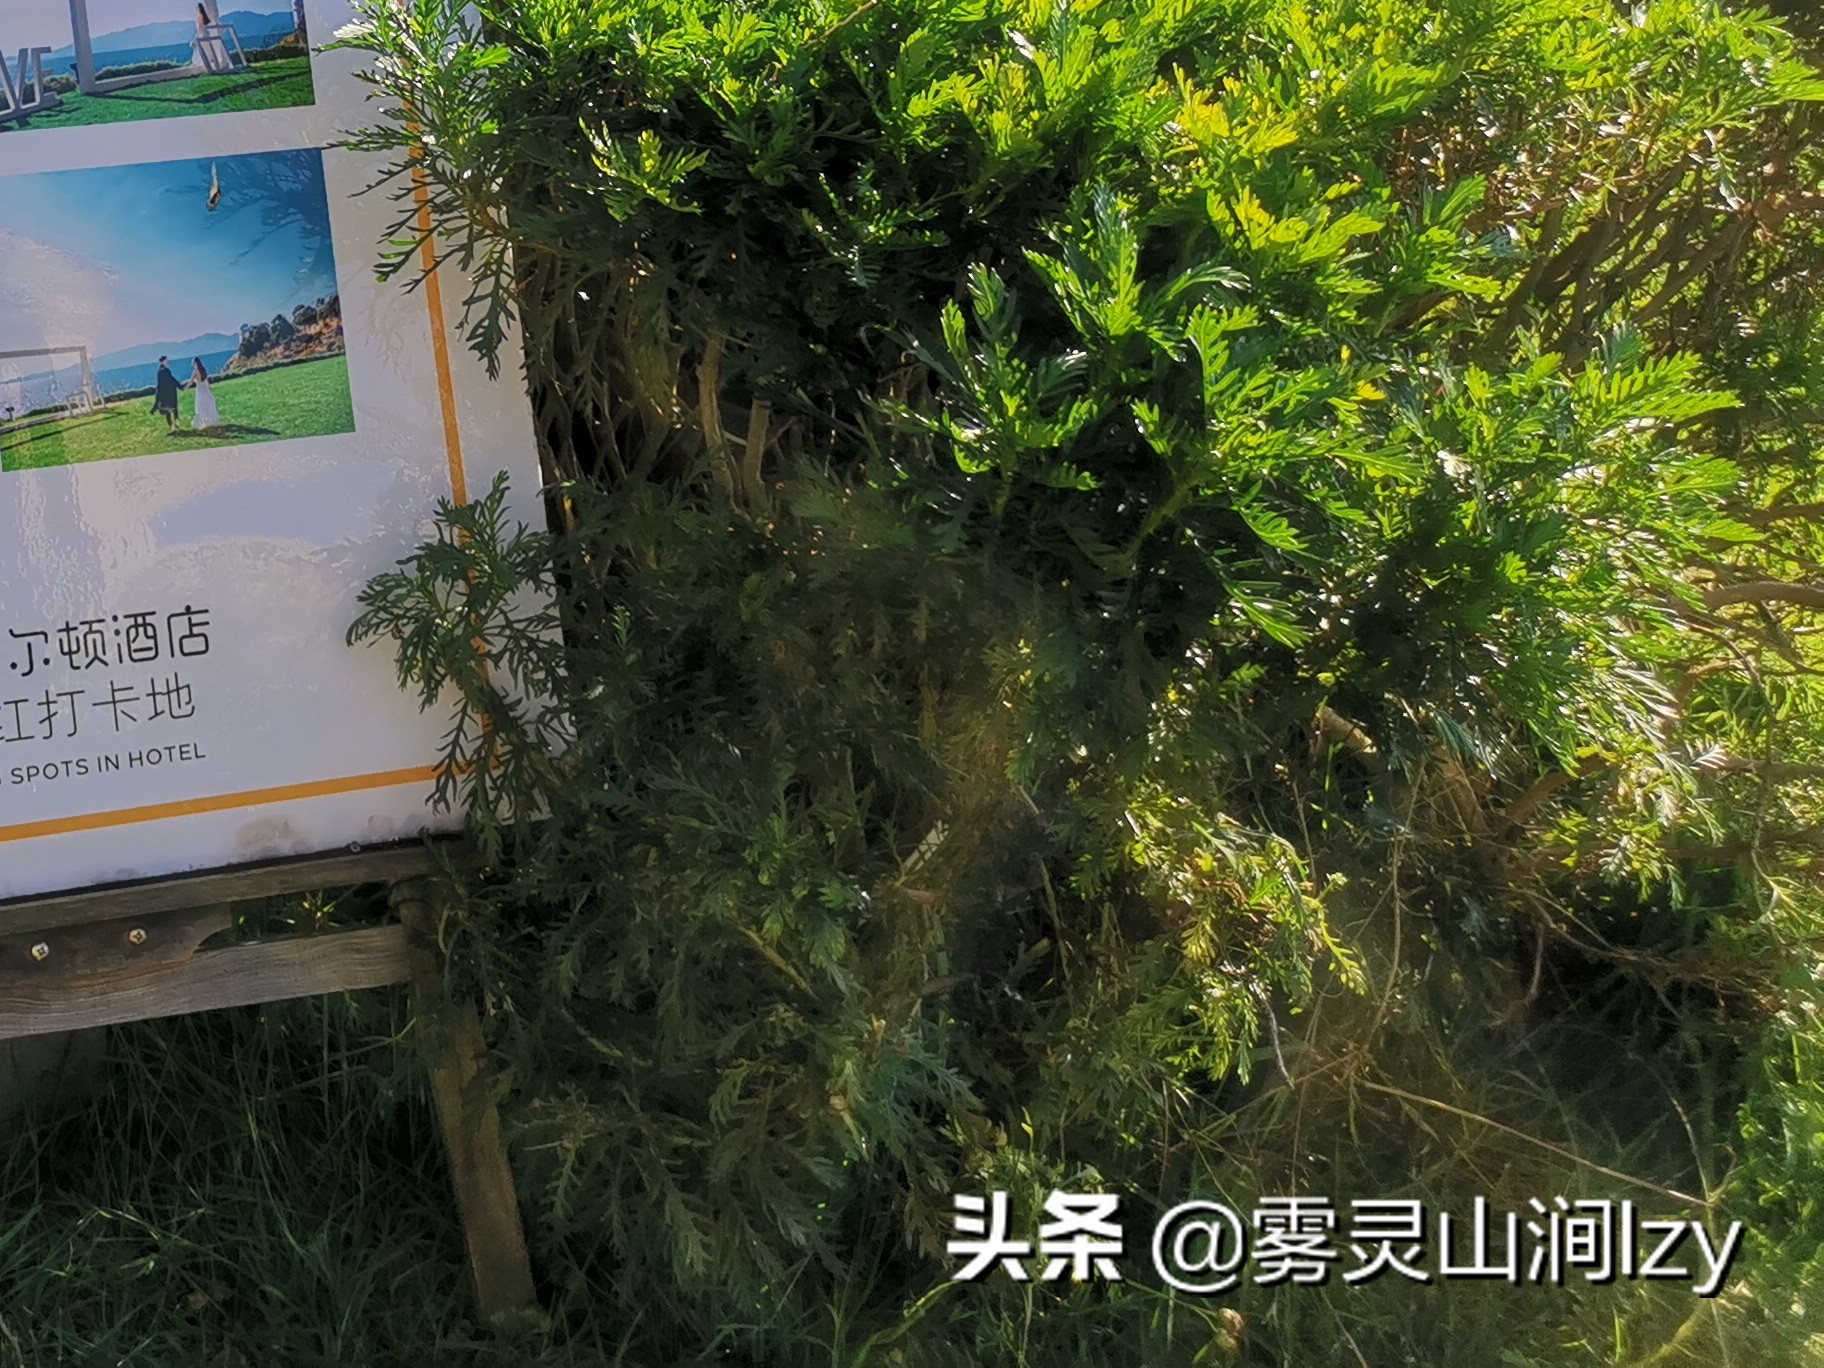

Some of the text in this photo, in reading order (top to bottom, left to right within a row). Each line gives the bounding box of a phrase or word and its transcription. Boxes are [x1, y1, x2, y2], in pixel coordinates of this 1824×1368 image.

[10, 758, 90, 786] SPOTS
[97, 755, 121, 774] IN
[128, 743, 207, 770] HOTEL
